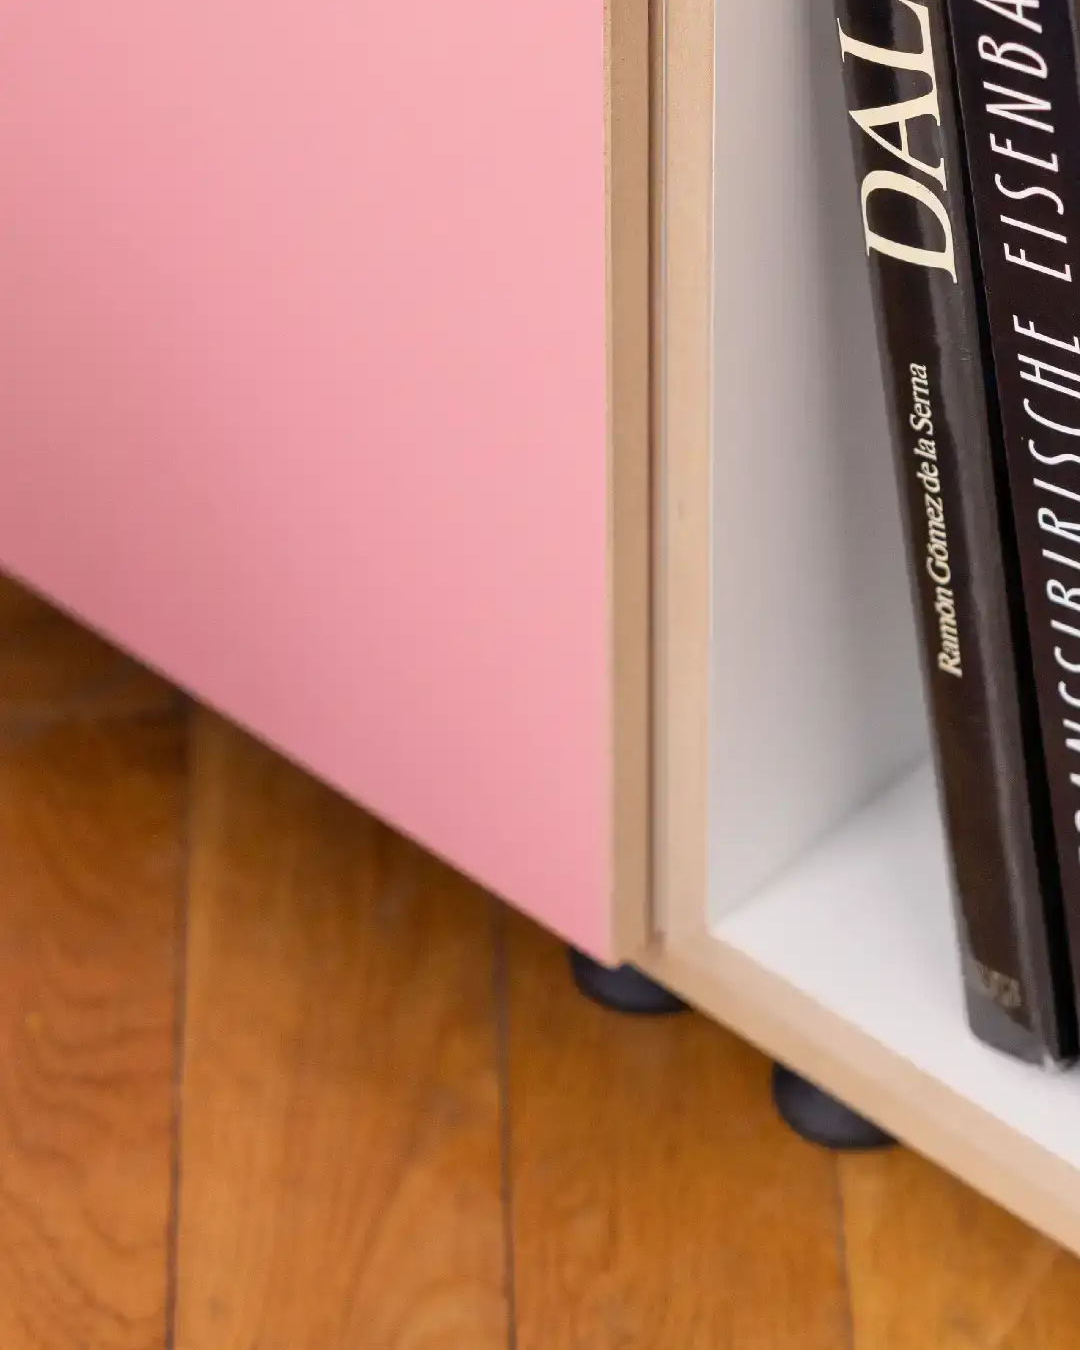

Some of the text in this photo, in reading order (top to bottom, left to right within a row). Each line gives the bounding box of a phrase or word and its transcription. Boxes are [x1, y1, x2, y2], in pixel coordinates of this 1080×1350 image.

[909, 362, 963, 678] Ramón Gómez de la Serna
